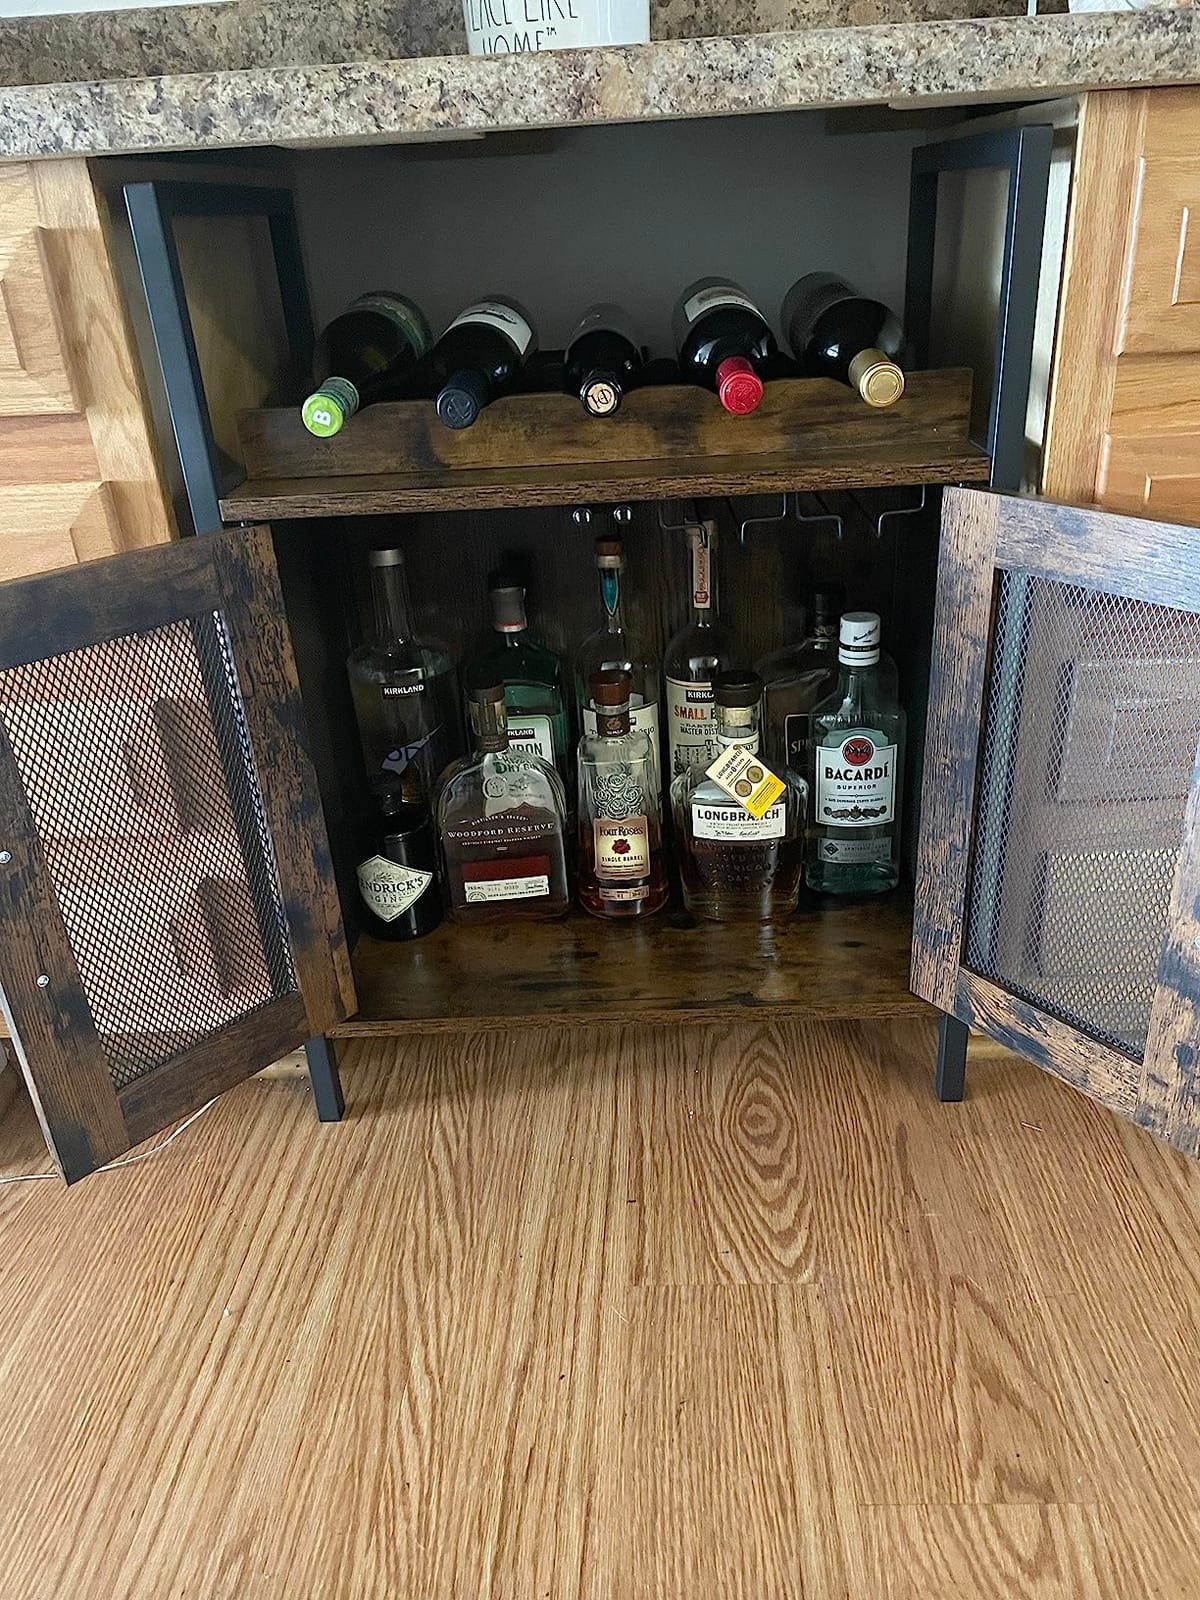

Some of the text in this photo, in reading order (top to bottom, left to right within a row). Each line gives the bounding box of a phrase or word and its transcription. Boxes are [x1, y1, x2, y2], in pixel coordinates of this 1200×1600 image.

[384, 684, 424, 695] KIRKLAND
[674, 704, 707, 721] SMALL
[825, 761, 889, 781] BACARDÍ
[697, 808, 778, 822] LONGBRACH
[447, 822, 554, 839] WOODFORD RESERVE
[618, 826, 644, 837] Roses
[374, 895, 397, 904] GIN
